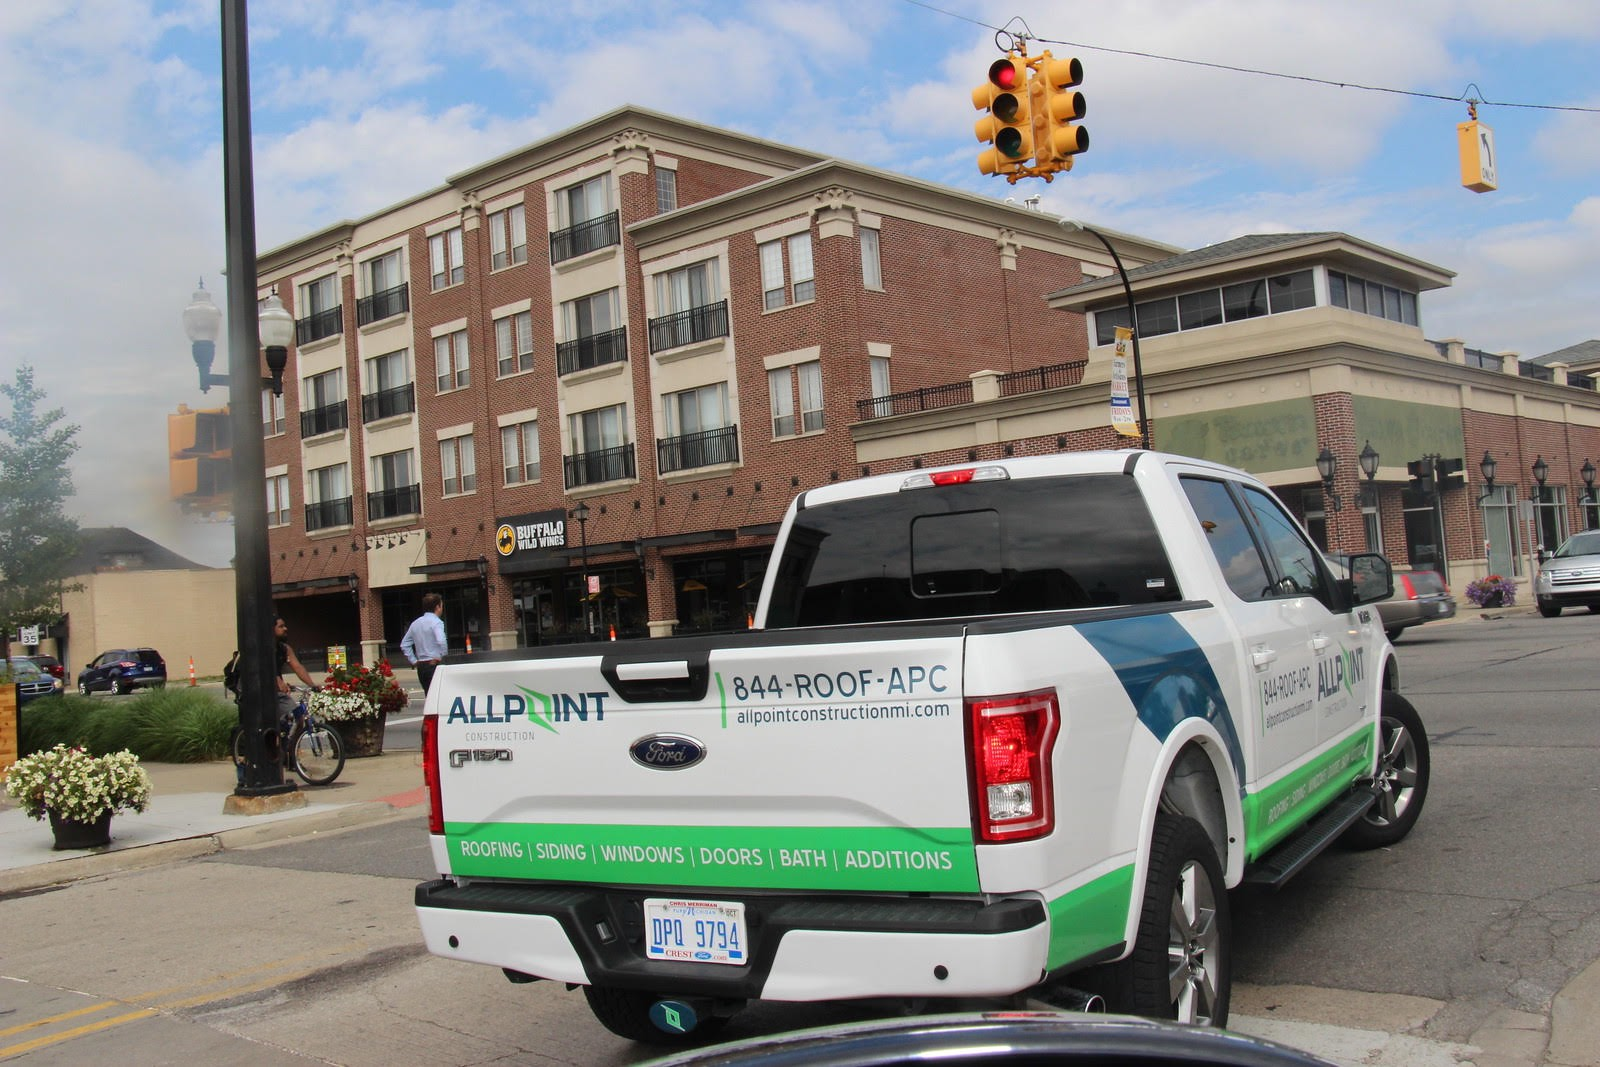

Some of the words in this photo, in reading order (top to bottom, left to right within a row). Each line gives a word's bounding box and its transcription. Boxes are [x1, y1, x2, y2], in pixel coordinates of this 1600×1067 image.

[516, 520, 564, 539] BUFFALO
[517, 538, 538, 550] WILD
[539, 535, 565, 548] WINGS
[23, 635, 37, 643] 35
[733, 664, 948, 701] 844-ROOF-APC
[1263, 666, 1312, 706] 844-ROOF-APC
[737, 702, 950, 727] allpointconstructionmi.com
[465, 731, 535, 742] CONSTRUCTION
[460, 840, 523, 858] ROOFING
[536, 842, 587, 861] SIDING
[600, 844, 685, 864] WINDOWS
[700, 847, 763, 866] DOORS
[780, 849, 827, 867] BATH
[845, 850, 952, 870] ADDITIONS
[652, 918, 684, 946] DPQ
[695, 920, 739, 950] 9794
[665, 950, 693, 958] CREST
